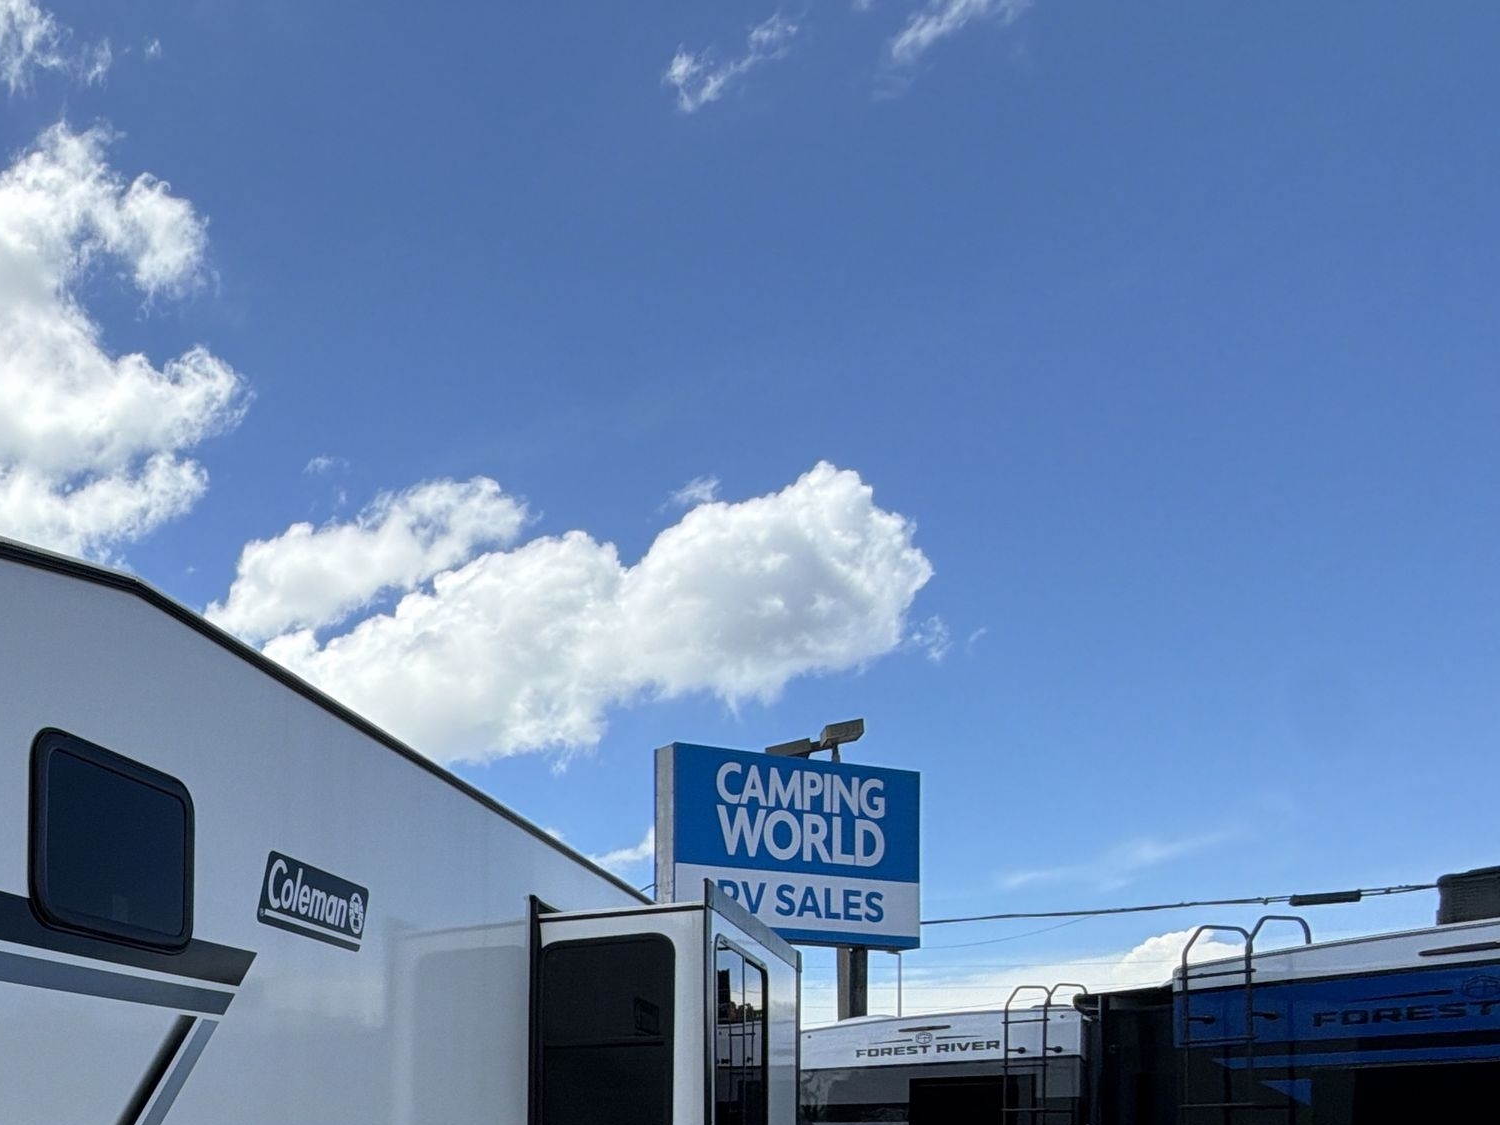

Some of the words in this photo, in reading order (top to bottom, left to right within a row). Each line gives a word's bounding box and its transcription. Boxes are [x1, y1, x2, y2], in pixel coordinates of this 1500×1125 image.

[716, 761, 886, 820] CAMPING
[716, 804, 886, 867] WORLD
[267, 858, 348, 929] Coleman
[775, 883, 885, 923] SALES
[1312, 1001, 1500, 1028] FOREST
[855, 1045, 931, 1059] FOREST
[936, 1040, 1001, 1054] RIVER
